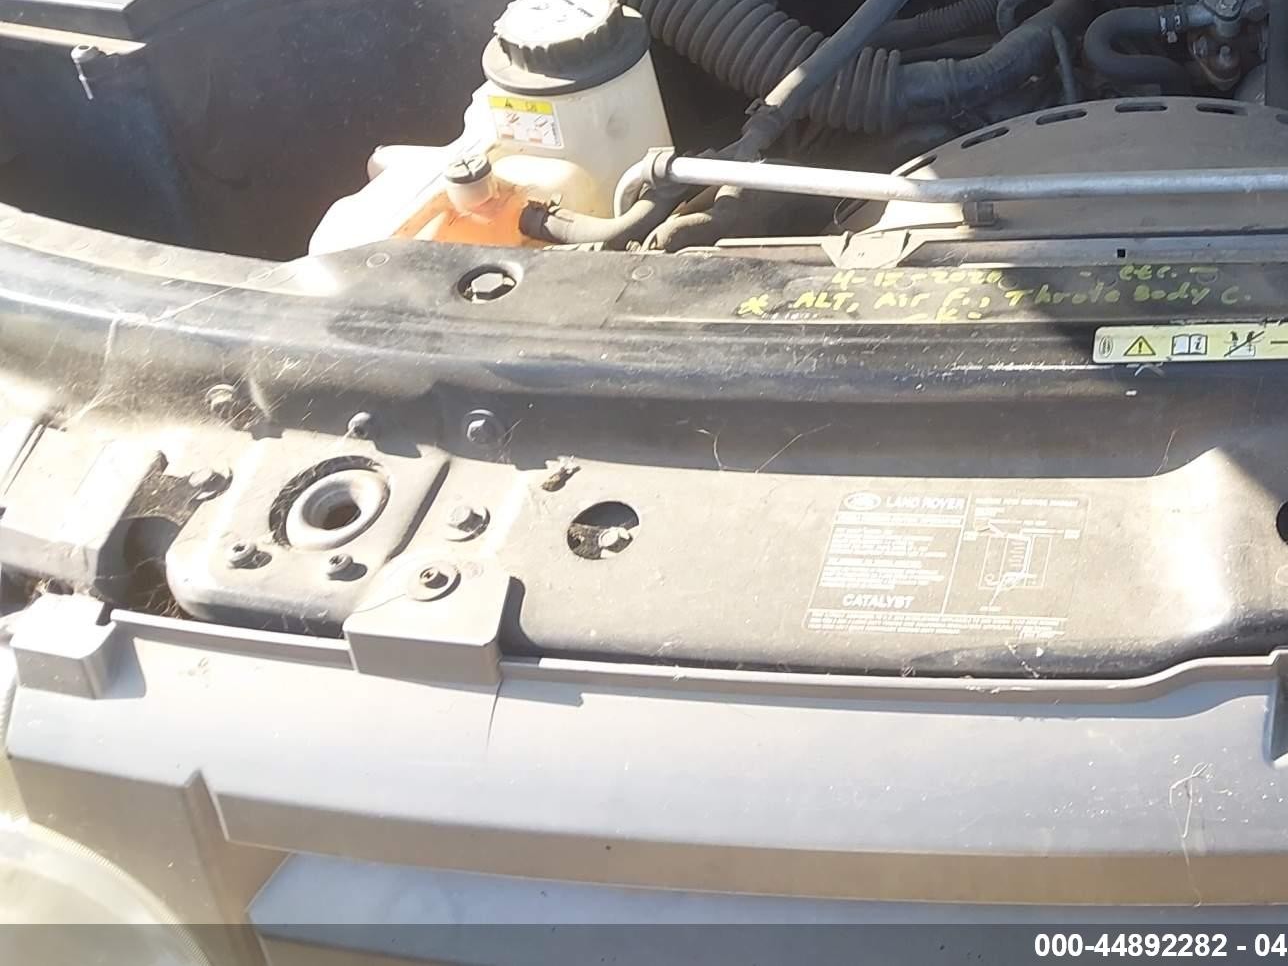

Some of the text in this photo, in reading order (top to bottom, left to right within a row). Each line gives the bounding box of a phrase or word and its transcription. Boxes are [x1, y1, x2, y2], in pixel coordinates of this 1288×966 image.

[874, 291, 930, 310] Air
[1133, 282, 1210, 305] Body
[885, 495, 921, 509] LAND
[841, 593, 915, 610] CATALYST
